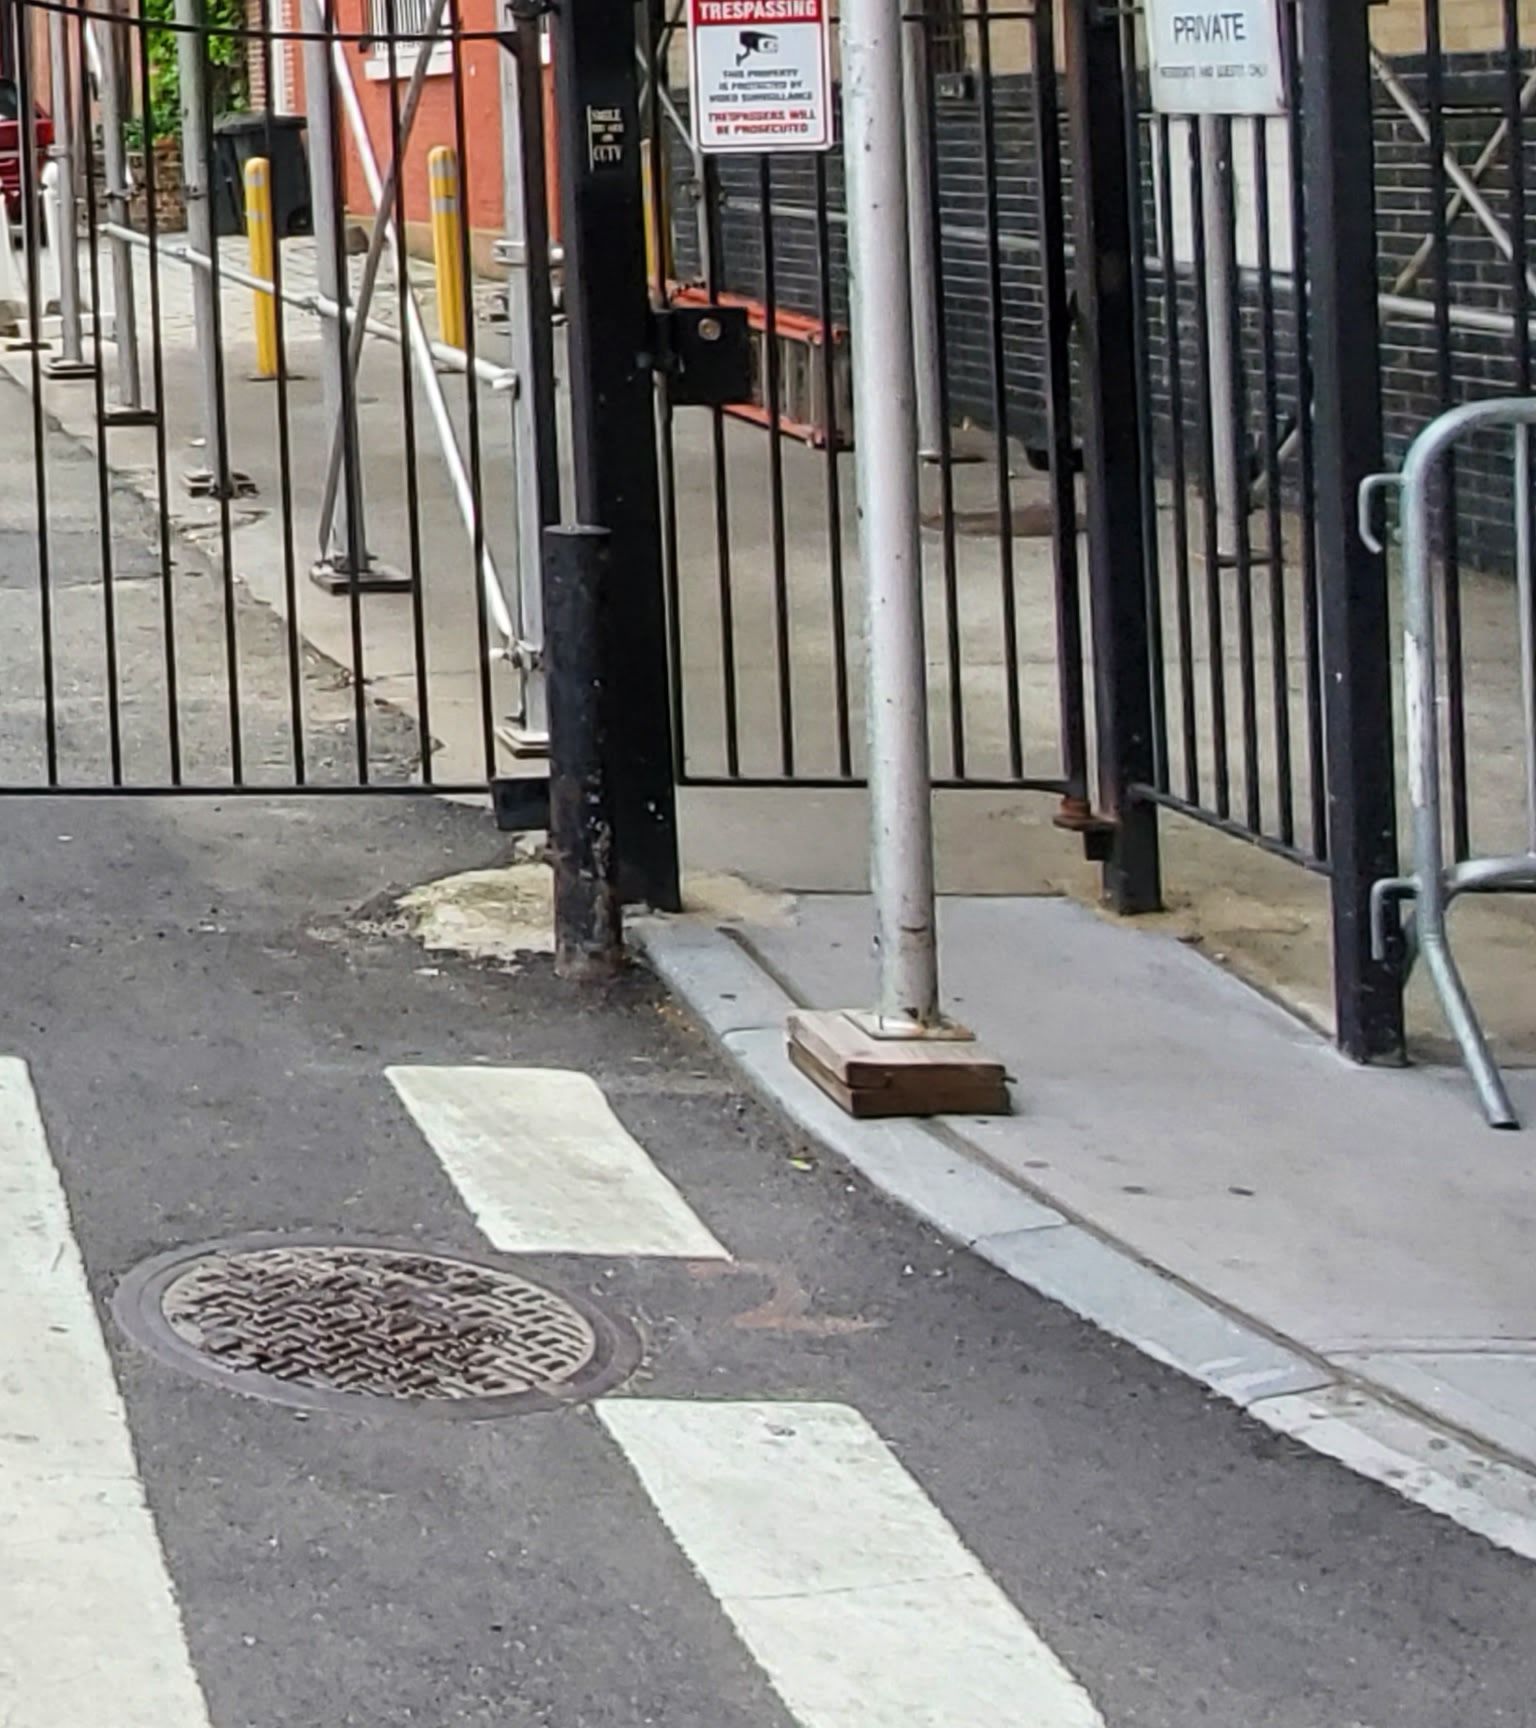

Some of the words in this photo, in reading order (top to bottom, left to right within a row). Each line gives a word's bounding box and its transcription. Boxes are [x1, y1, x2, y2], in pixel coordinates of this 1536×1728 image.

[699, 0, 818, 20] TRESPASSING
[1173, 13, 1247, 43] PRIVATE
[734, 123, 809, 134] PROSECUTED
[593, 145, 623, 162] CCTV
